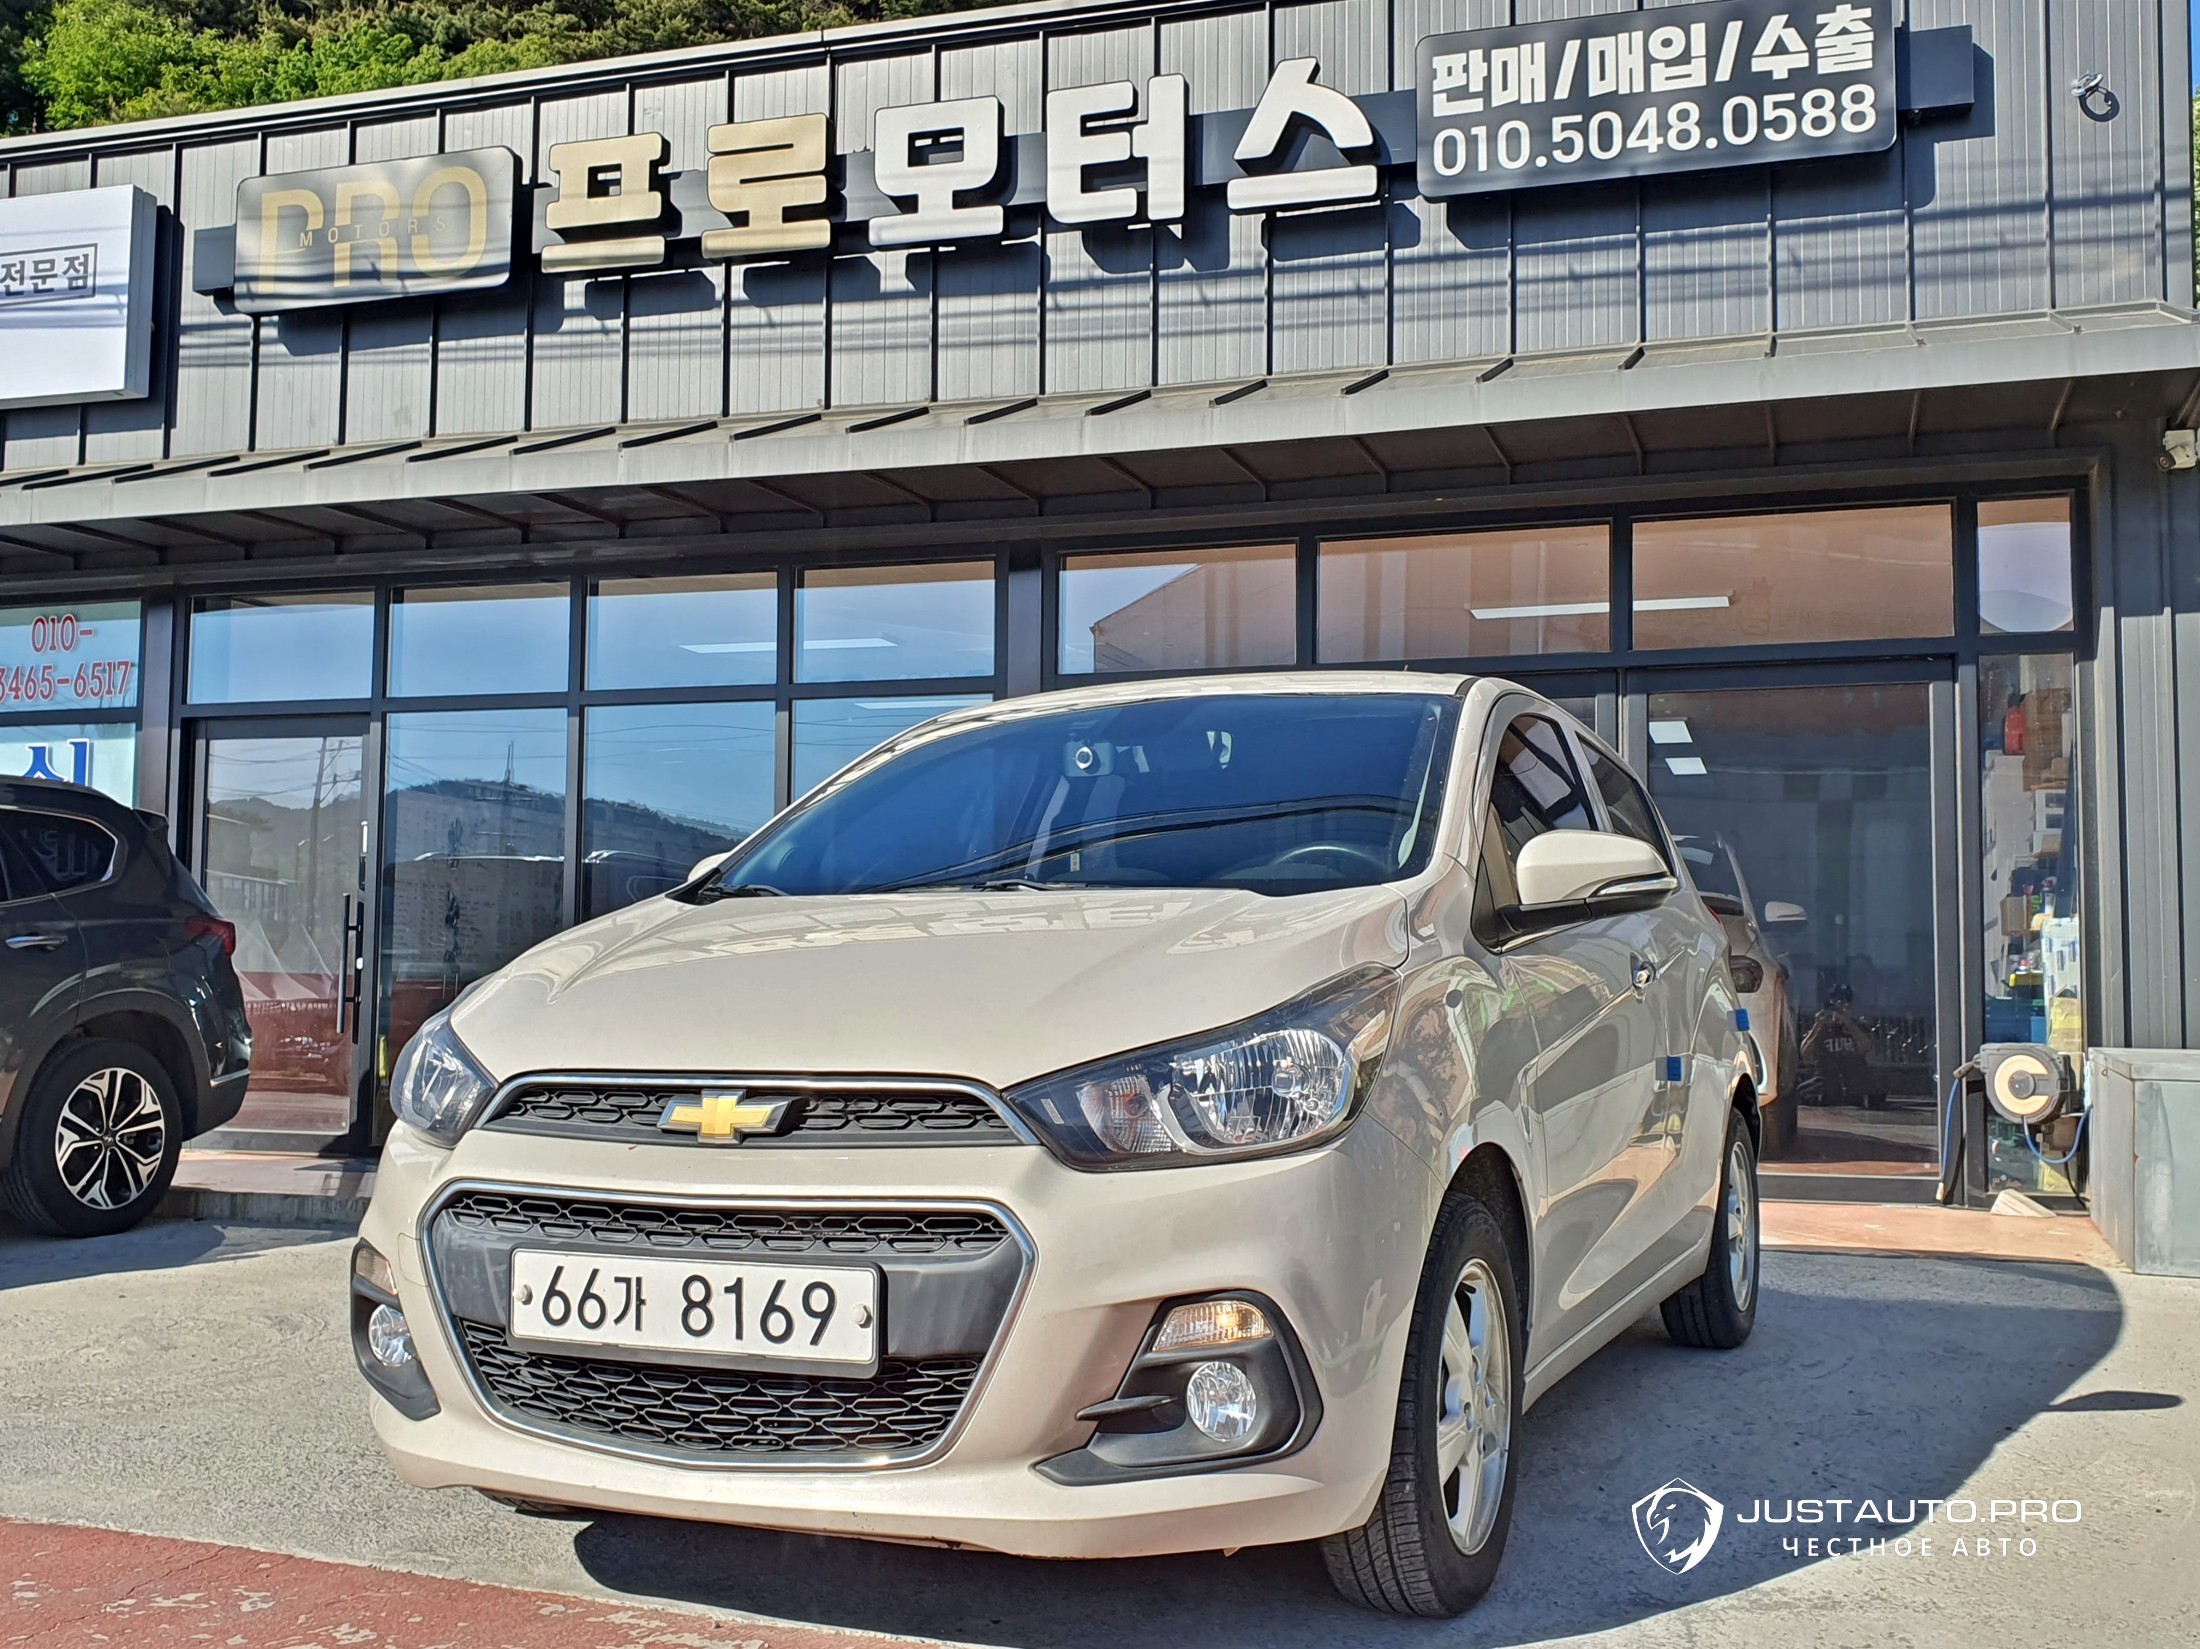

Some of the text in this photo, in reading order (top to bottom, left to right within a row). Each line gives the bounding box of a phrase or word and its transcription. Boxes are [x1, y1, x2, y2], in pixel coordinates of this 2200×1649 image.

[1432, 3, 1875, 118] 판매/매입/수출
[540, 56, 1378, 274] 프로모터스
[1433, 83, 1877, 177] 010.5048.0588
[257, 166, 488, 294] PRO
[300, 216, 447, 247] MOTORS
[0, 254, 90, 297] 전문점
[31, 614, 94, 653] 010-
[542, 1265, 837, 1346] 66가 8169
